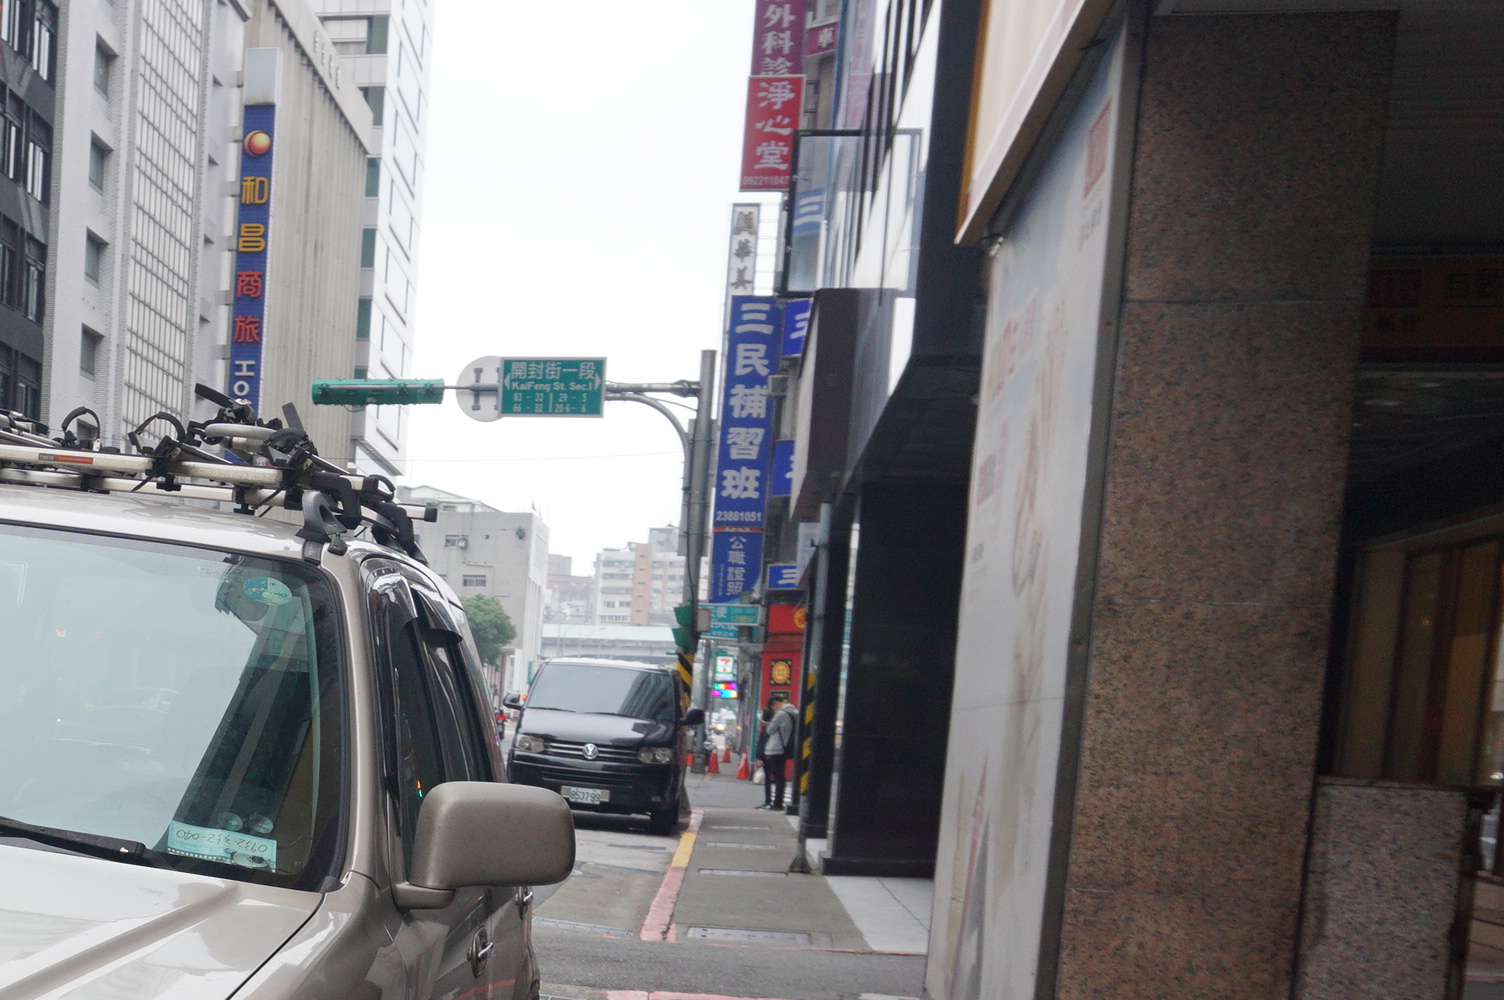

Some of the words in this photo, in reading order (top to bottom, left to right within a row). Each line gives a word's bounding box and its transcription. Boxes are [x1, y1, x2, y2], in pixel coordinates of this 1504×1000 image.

[754, 81, 795, 170] 淨心堂
[511, 361, 596, 379] 開封街一段
[721, 303, 775, 499] 三民補習班
